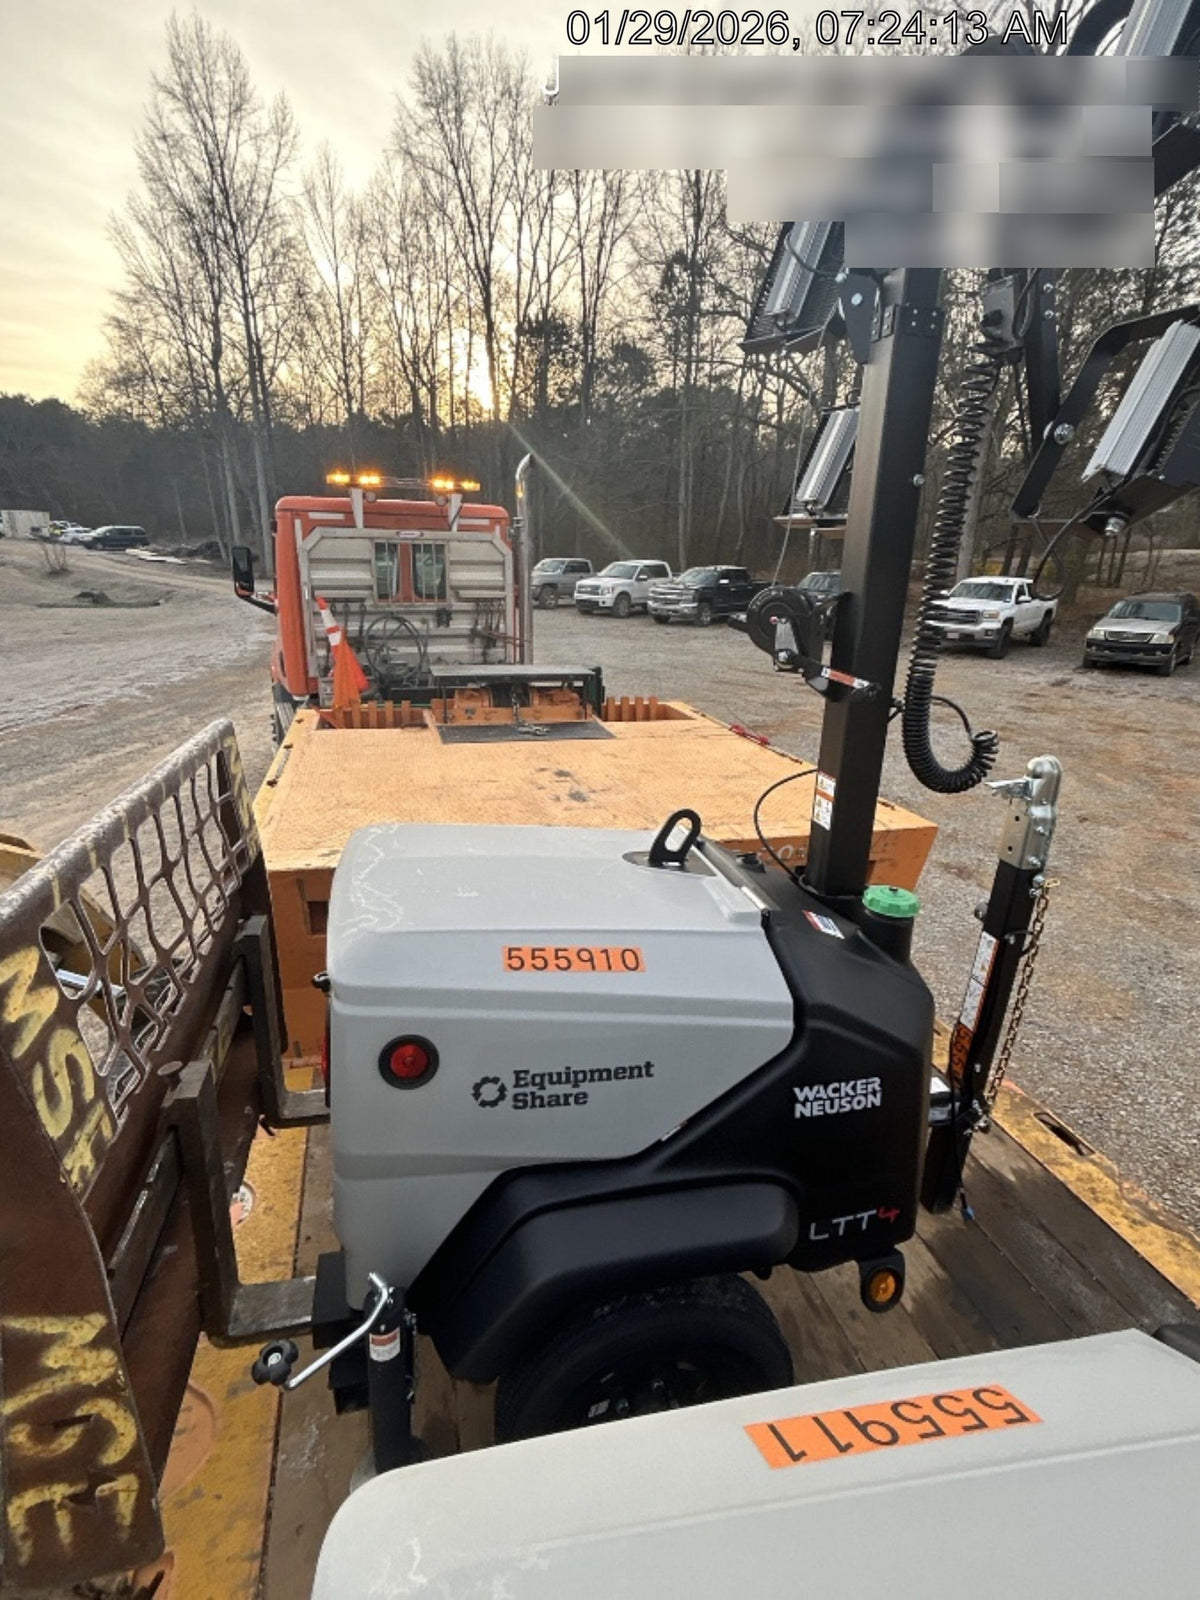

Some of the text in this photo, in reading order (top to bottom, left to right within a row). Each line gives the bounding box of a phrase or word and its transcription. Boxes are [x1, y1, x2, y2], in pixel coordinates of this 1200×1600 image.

[506, 947, 641, 972] 555910
[513, 1061, 655, 1090] Equipment
[793, 1077, 881, 1101] WACKER
[512, 1091, 589, 1110] Share
[794, 1092, 882, 1119] NEUSON
[809, 1207, 901, 1241] LTT4
[766, 1387, 1031, 1462] 555911
